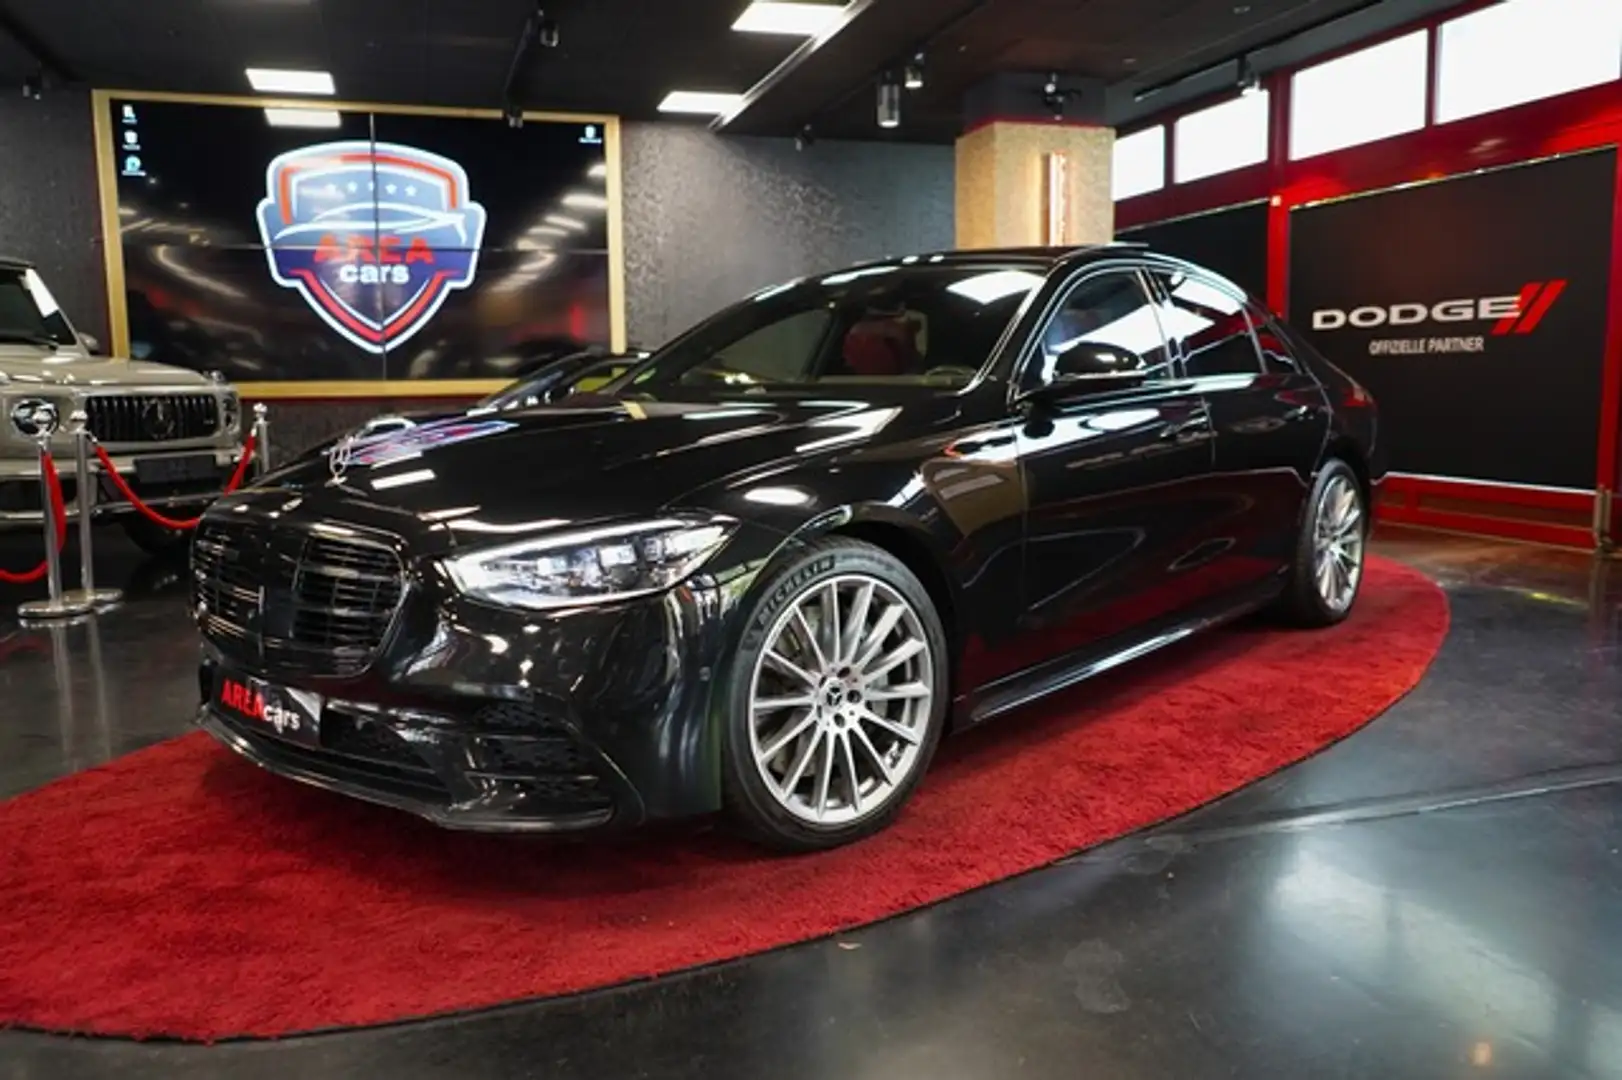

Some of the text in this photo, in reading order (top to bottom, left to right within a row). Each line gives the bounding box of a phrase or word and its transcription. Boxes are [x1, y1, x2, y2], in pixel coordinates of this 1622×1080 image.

[314, 234, 434, 264] AREA
[340, 263, 410, 284] cars
[1312, 296, 1522, 330] DODGE
[1369, 336, 1484, 355] OFFIZIELLE PARTNER
